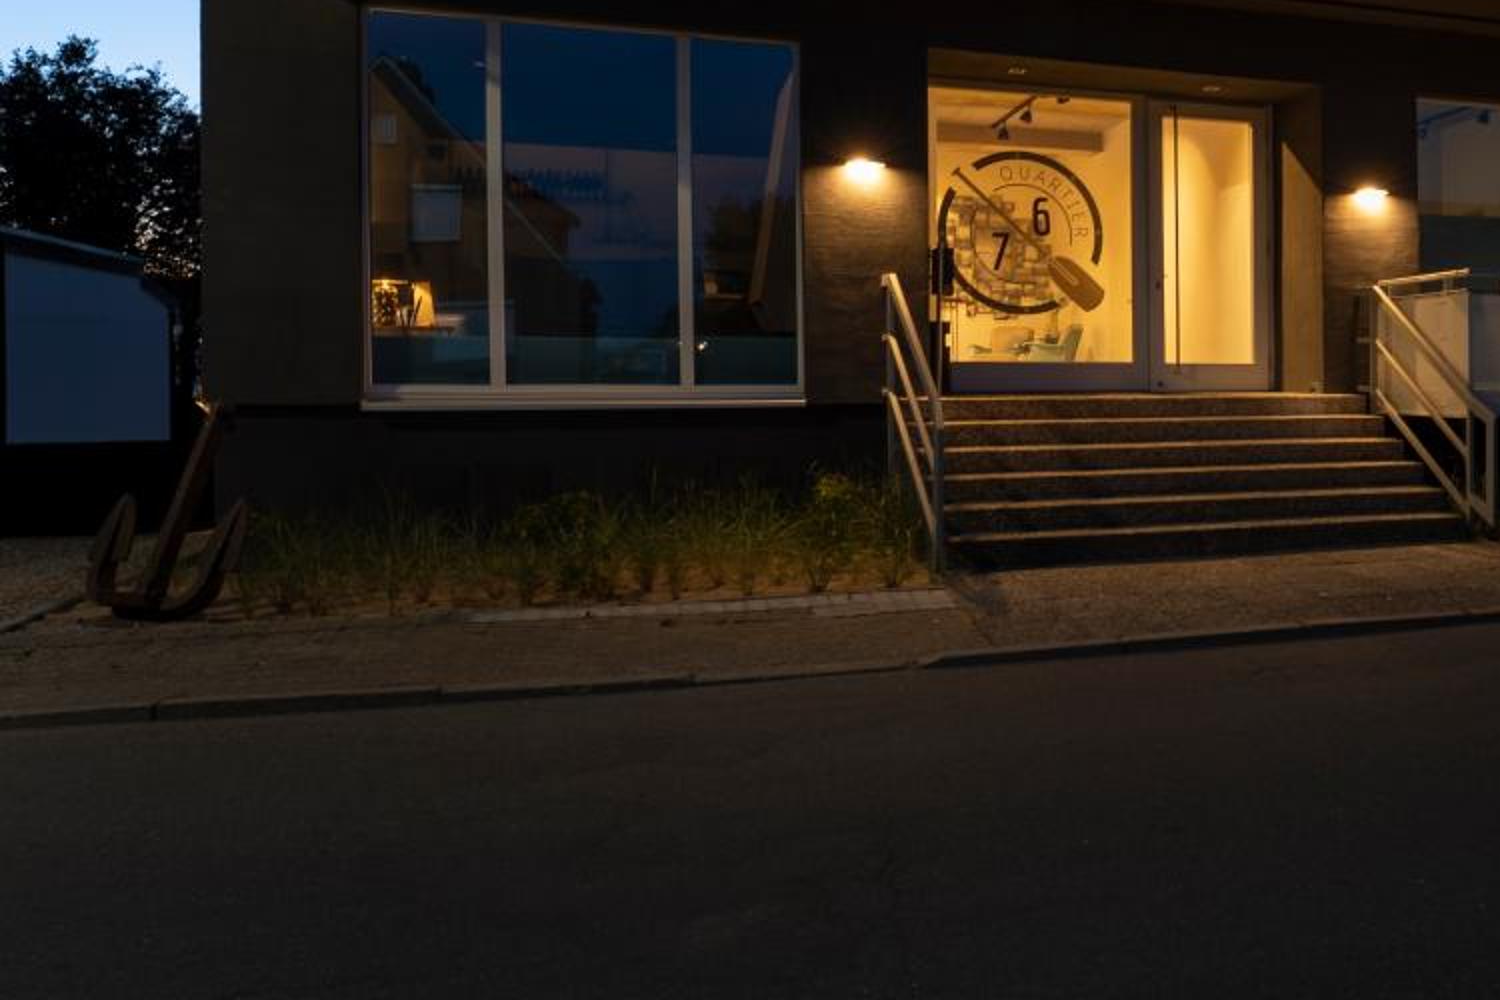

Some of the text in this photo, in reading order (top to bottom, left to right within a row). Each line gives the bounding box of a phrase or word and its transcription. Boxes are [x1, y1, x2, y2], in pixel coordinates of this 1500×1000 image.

[1000, 166, 1089, 238] QUARTIER
[1032, 197, 1050, 237] 6
[992, 232, 1010, 270] 7
